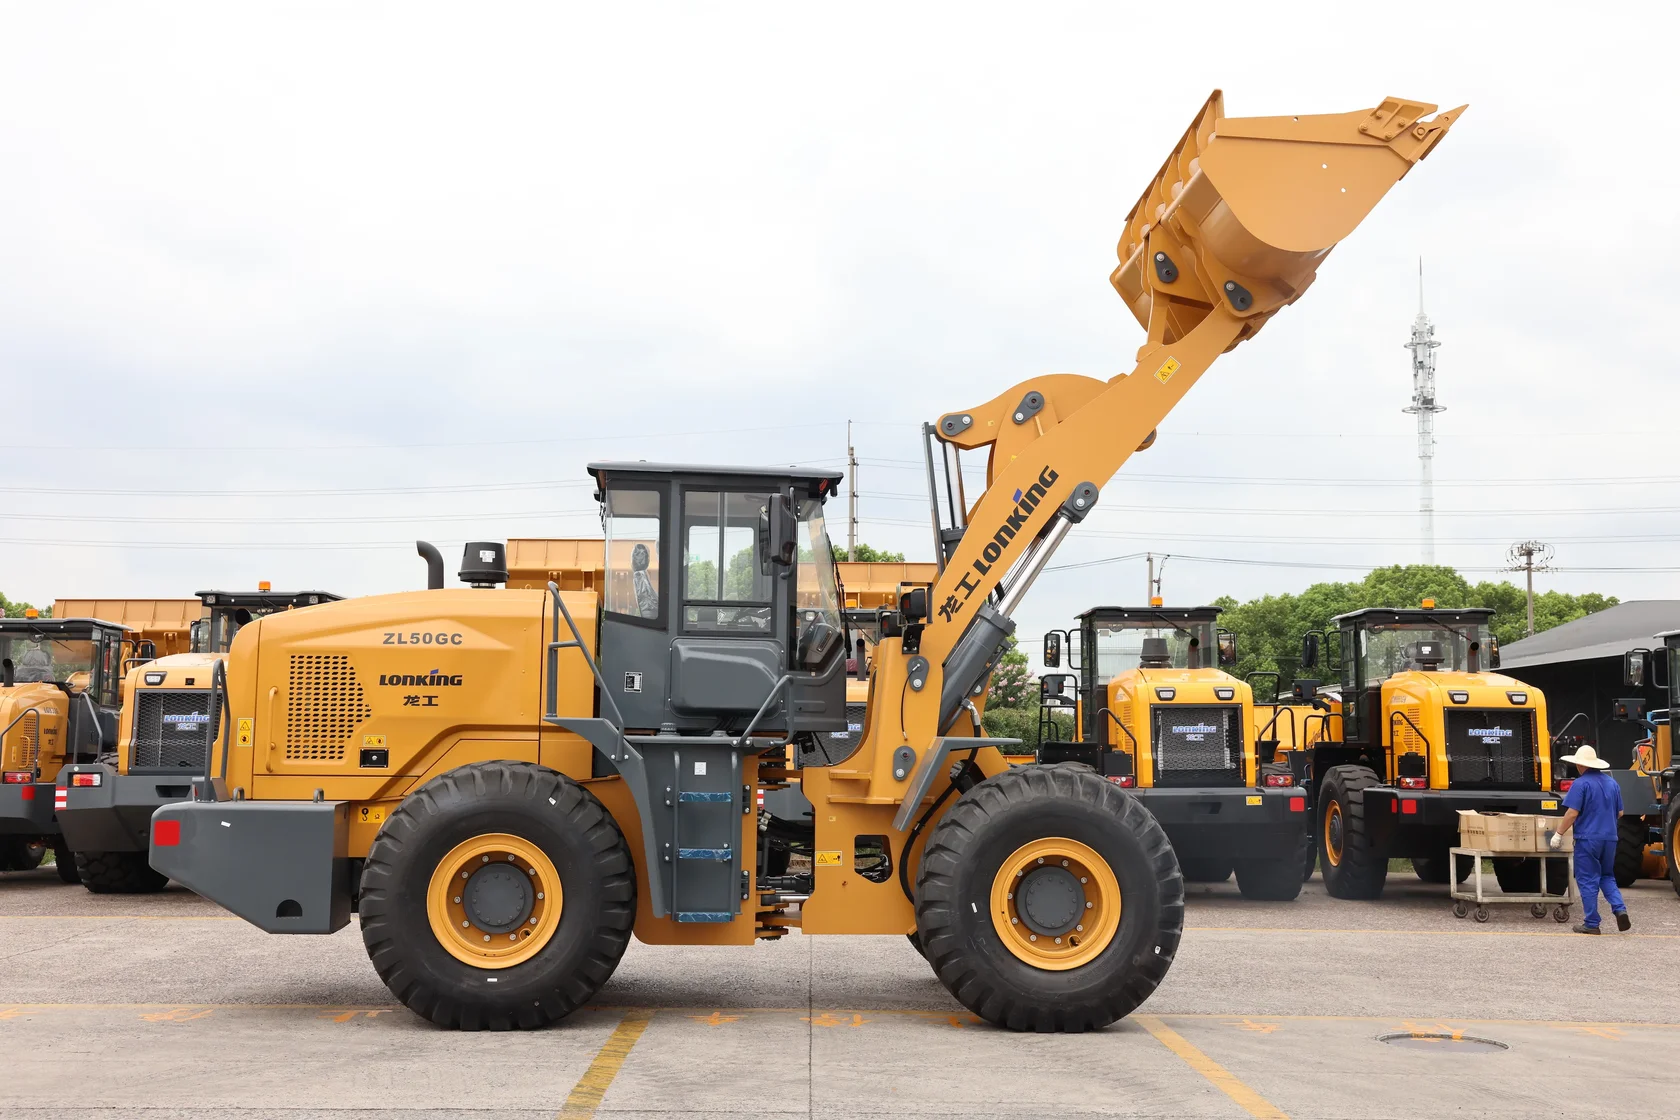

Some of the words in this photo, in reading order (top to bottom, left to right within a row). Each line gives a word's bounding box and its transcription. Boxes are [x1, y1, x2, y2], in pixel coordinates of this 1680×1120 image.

[937, 571, 981, 623] 龙工
[973, 465, 1059, 576] LONKING
[382, 632, 463, 645] ZL50GC
[379, 668, 463, 686] LONKING
[403, 695, 439, 706] 龙工
